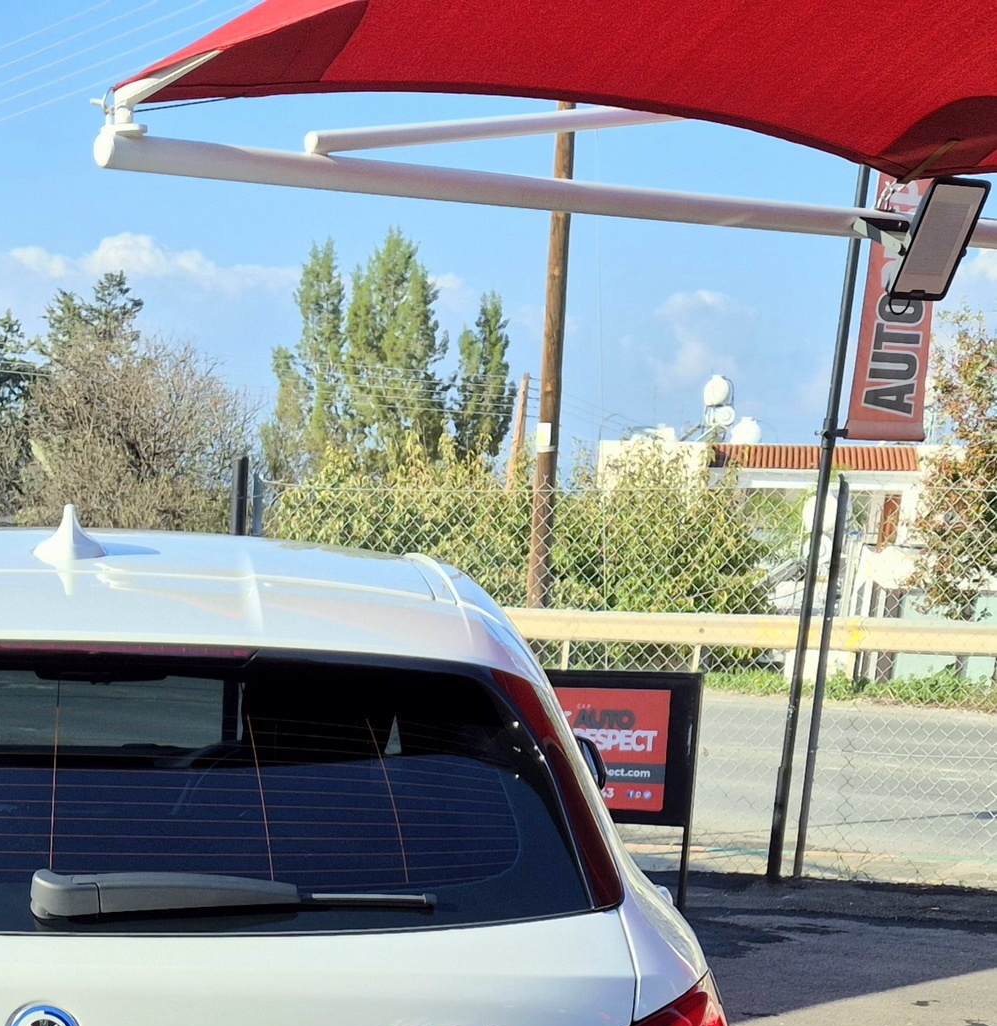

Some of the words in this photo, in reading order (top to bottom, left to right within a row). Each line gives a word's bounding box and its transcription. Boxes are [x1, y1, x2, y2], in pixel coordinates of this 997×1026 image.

[862, 291, 927, 418] AUTO
[574, 709, 636, 730] AUTO
[607, 768, 651, 778] ect.com
